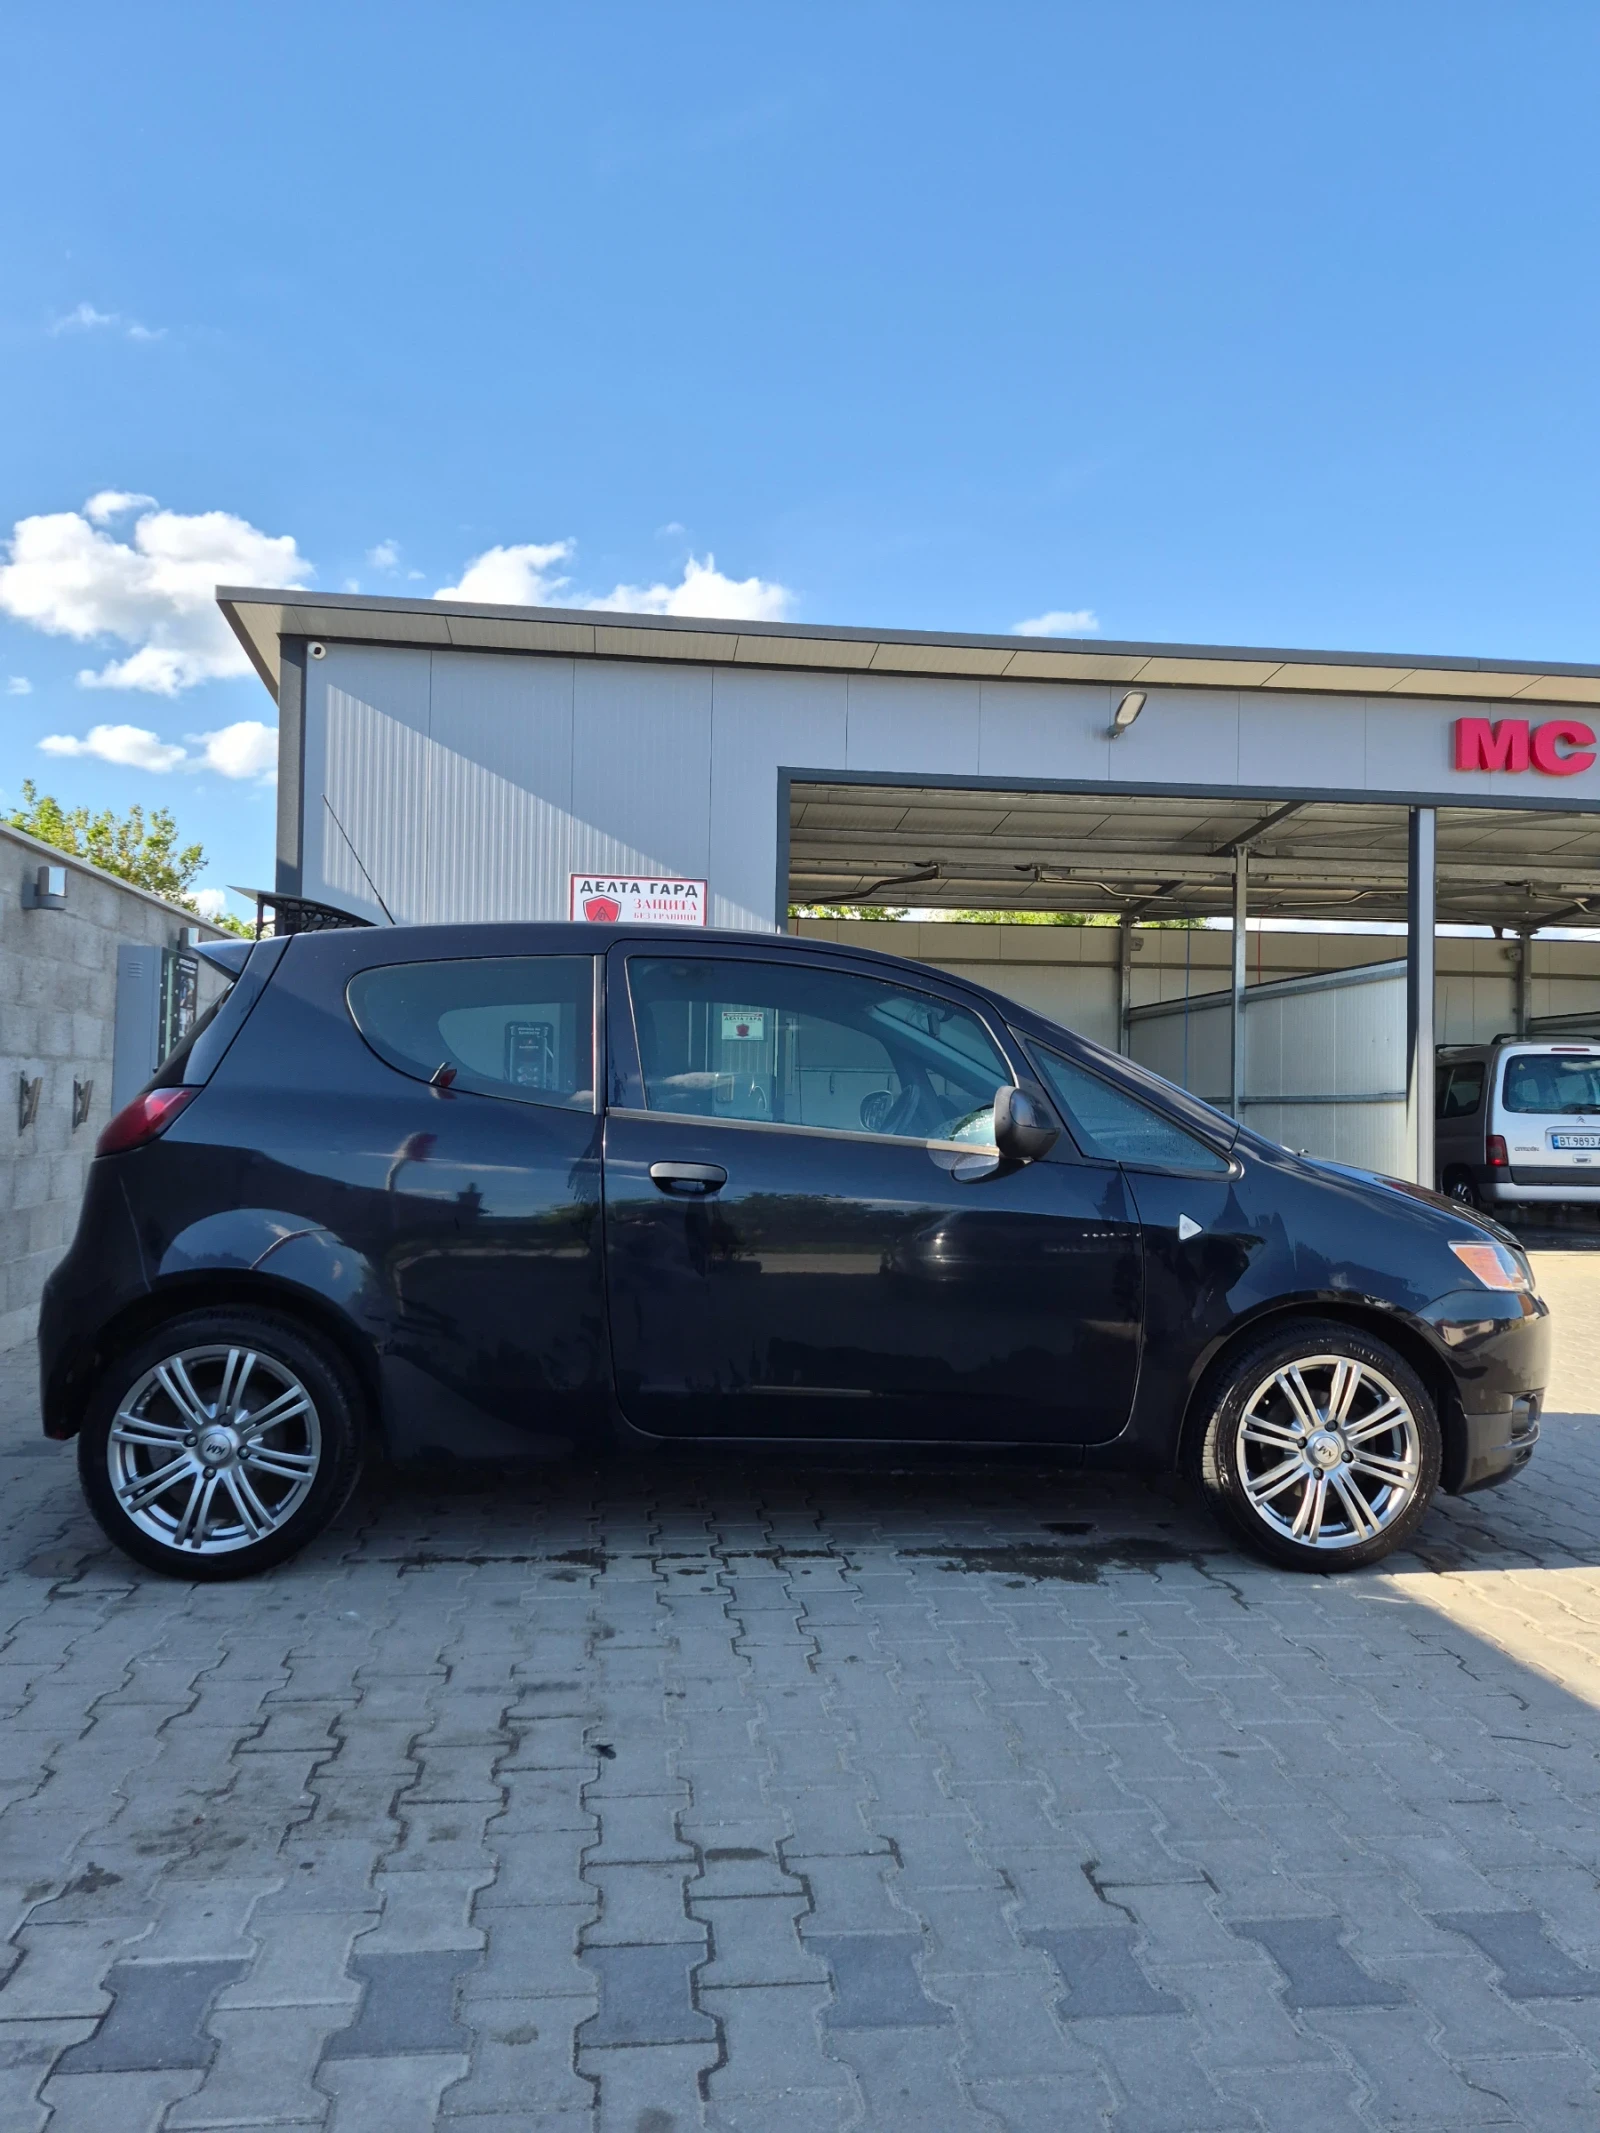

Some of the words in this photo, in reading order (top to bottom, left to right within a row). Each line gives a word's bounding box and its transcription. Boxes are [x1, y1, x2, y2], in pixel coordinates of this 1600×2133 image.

[580, 880, 641, 894] ДЕЛТА
[650, 883, 698, 898] ГАРД
[633, 898, 697, 911] ЗАЩИТА
